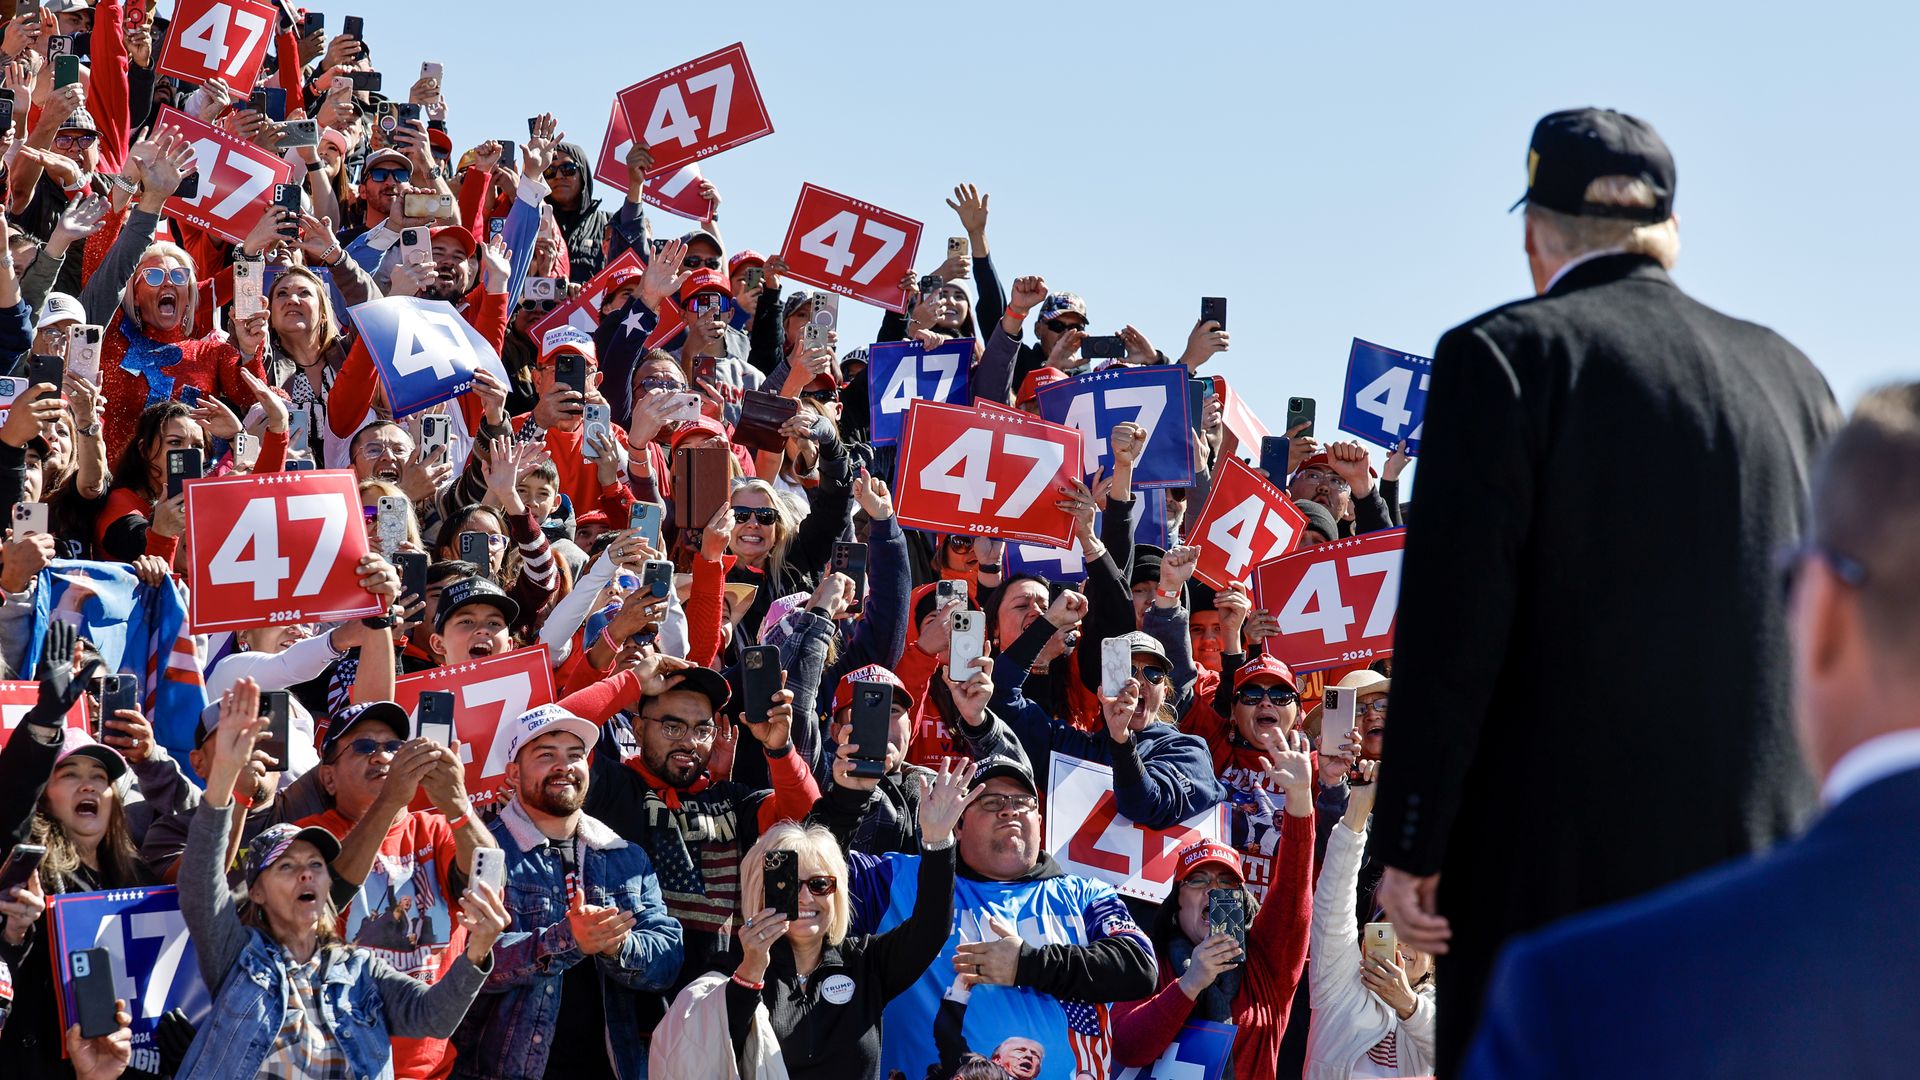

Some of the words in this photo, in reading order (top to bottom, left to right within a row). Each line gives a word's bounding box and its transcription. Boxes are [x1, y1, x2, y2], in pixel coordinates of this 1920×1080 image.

[180, 3, 268, 77] 47
[643, 64, 735, 148] 47
[696, 144, 719, 158] 2024
[180, 138, 276, 220] 47
[641, 192, 661, 206] 2024
[186, 214, 211, 229] 2024
[800, 210, 907, 286] 47
[830, 282, 853, 296] 2024
[392, 304, 482, 381] 47
[546, 332, 562, 341] MAKE
[881, 353, 961, 414] 47
[1065, 385, 1167, 475] 47
[1389, 442, 1411, 454] 204
[919, 427, 1064, 519] 47
[969, 523, 1000, 536] 2024
[208, 493, 349, 601] 47
[1207, 494, 1294, 590] 47
[448, 582, 470, 596] MAKE
[1277, 549, 1403, 645] 47
[269, 609, 301, 623] 2024
[1342, 648, 1373, 661] 2024
[847, 667, 869, 684] MAKE
[1245, 663, 1265, 675] GREAT
[521, 709, 546, 724] MAKE
[528, 716, 557, 732] GREAT
[1068, 789, 1202, 885] 47
[1184, 848, 1208, 866] GREAT
[1211, 848, 1235, 865] AGAIN
[95, 910, 190, 1020] 47
[371, 945, 432, 972] TRUMP
[825, 982, 852, 992] TRUMP
